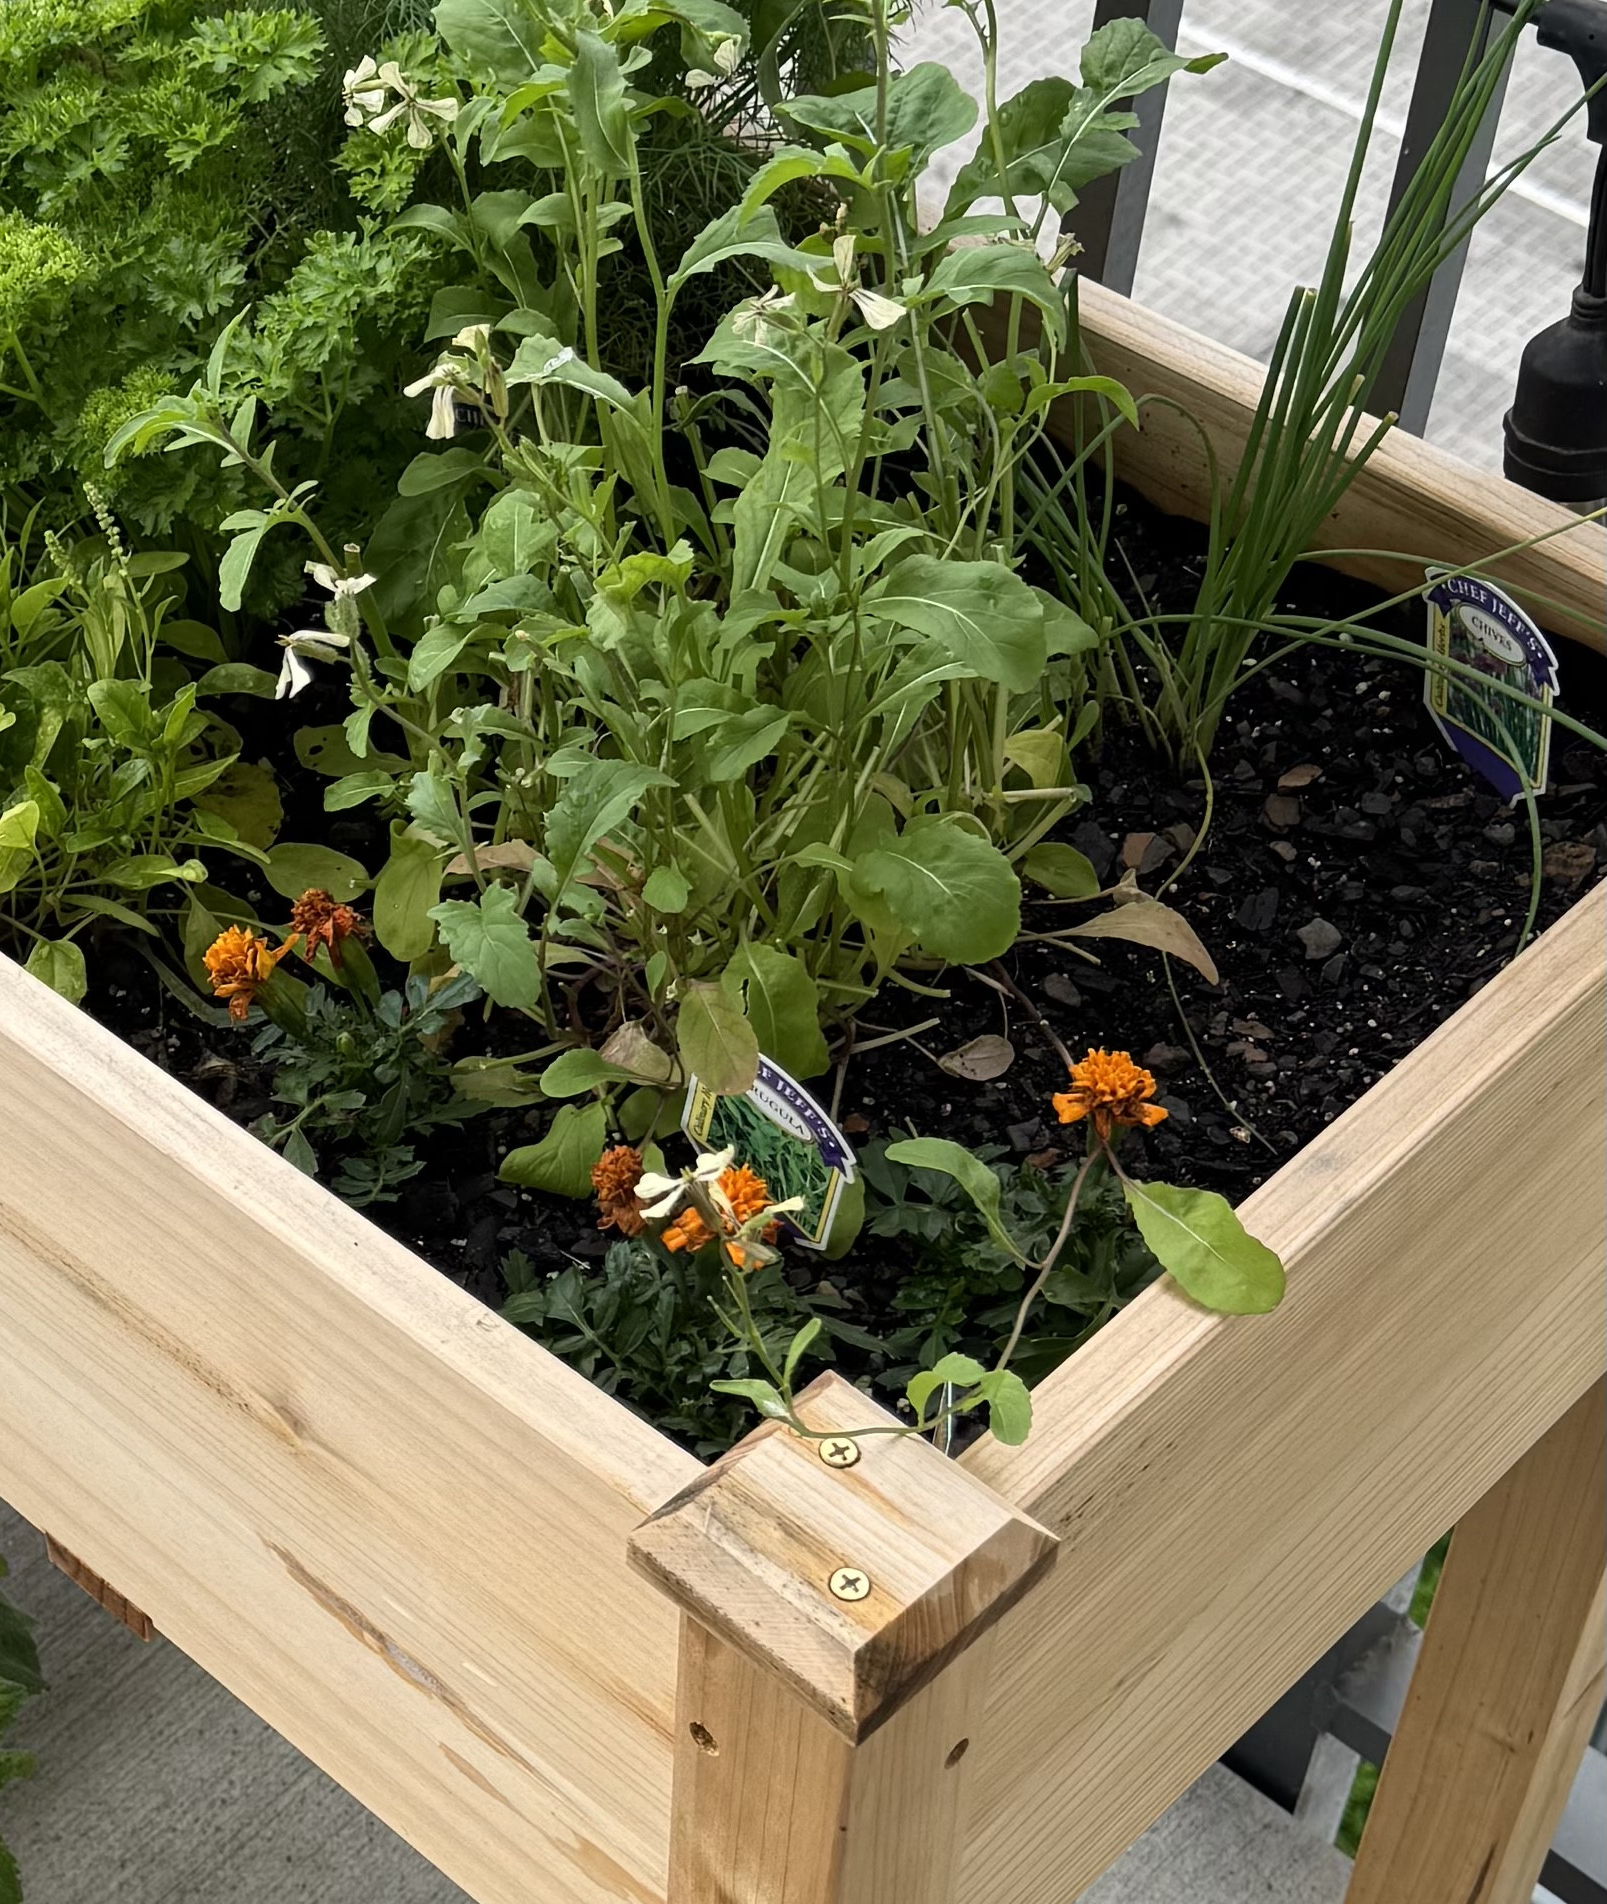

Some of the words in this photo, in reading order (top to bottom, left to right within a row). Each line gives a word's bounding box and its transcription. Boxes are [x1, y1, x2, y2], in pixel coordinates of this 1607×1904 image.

[1447, 578, 1489, 603] CHEF
[1491, 598, 1537, 651] JEFF'S
[1471, 615, 1512, 651] CHIVES
[753, 1086, 805, 1135] RUGULA
[776, 1079, 831, 1139] JEFF'S
